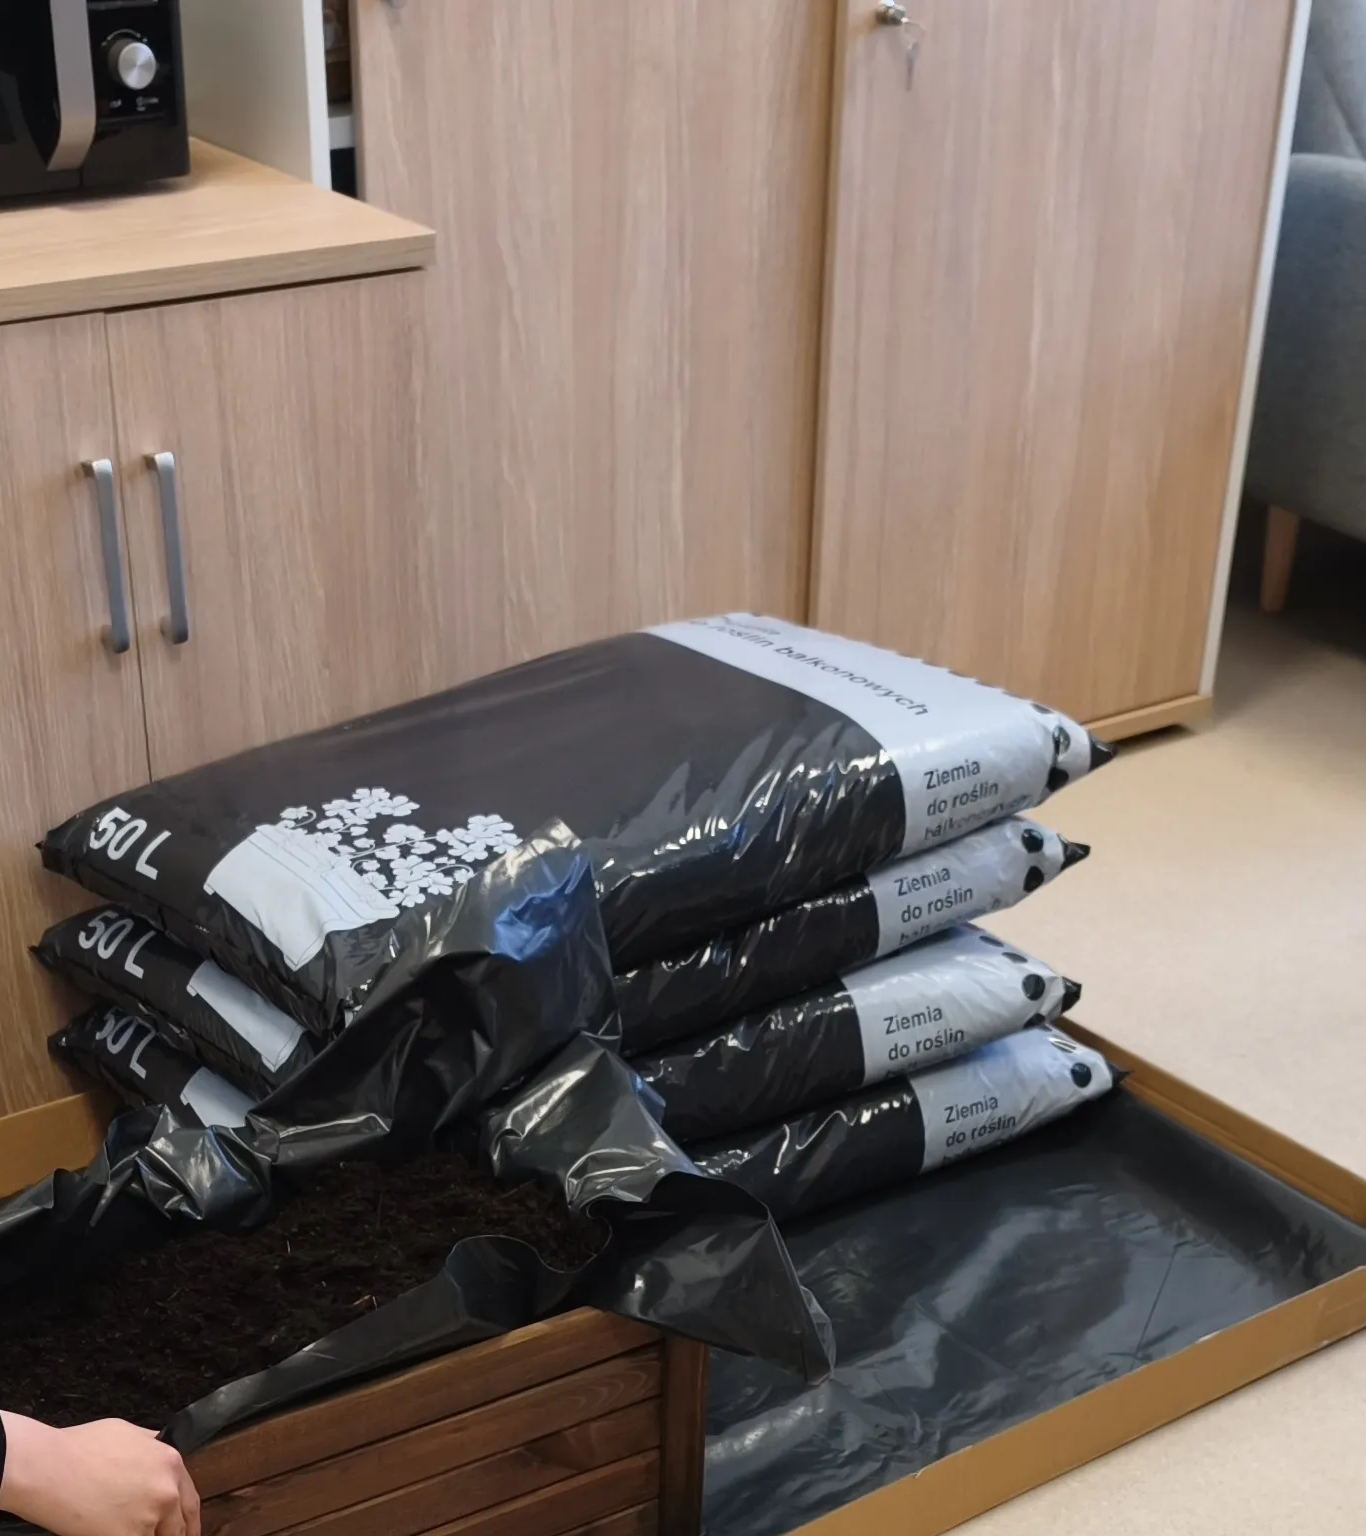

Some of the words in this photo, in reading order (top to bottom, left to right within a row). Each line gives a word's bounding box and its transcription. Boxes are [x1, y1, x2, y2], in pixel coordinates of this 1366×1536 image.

[773, 646, 929, 716] balkonowych
[923, 759, 981, 790] Ziemia
[926, 798, 948, 817] do
[952, 781, 999, 808] roślin
[89, 806, 148, 861] 50
[135, 829, 172, 881] L
[893, 867, 951, 897] Ziemia
[901, 904, 923, 923] do
[927, 886, 973, 915] roślin
[78, 909, 135, 960] 50
[124, 929, 157, 980] L
[882, 1005, 943, 1035] Ziemia
[95, 1005, 140, 1055] 50
[129, 1027, 157, 1080] L
[888, 1042, 910, 1061] do
[915, 1027, 965, 1054] roślin
[943, 1094, 999, 1124] Ziemia
[945, 1131, 967, 1148] do
[970, 1114, 1017, 1141] roślin
